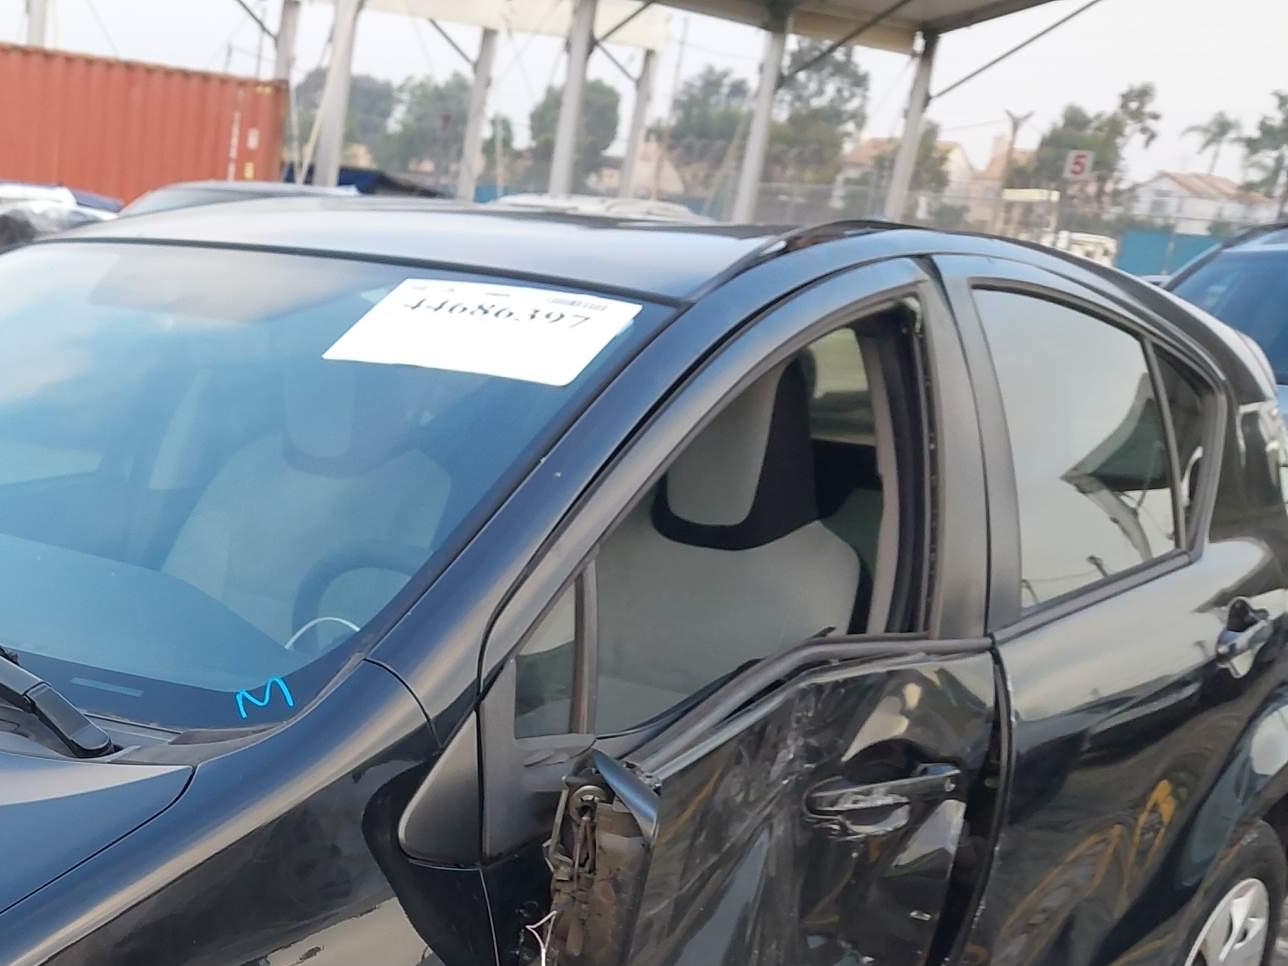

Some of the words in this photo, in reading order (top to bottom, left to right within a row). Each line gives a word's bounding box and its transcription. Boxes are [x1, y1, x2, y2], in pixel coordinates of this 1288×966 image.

[1070, 154, 1088, 176] 5
[403, 296, 592, 330] 44686397
[235, 675, 294, 719] M
